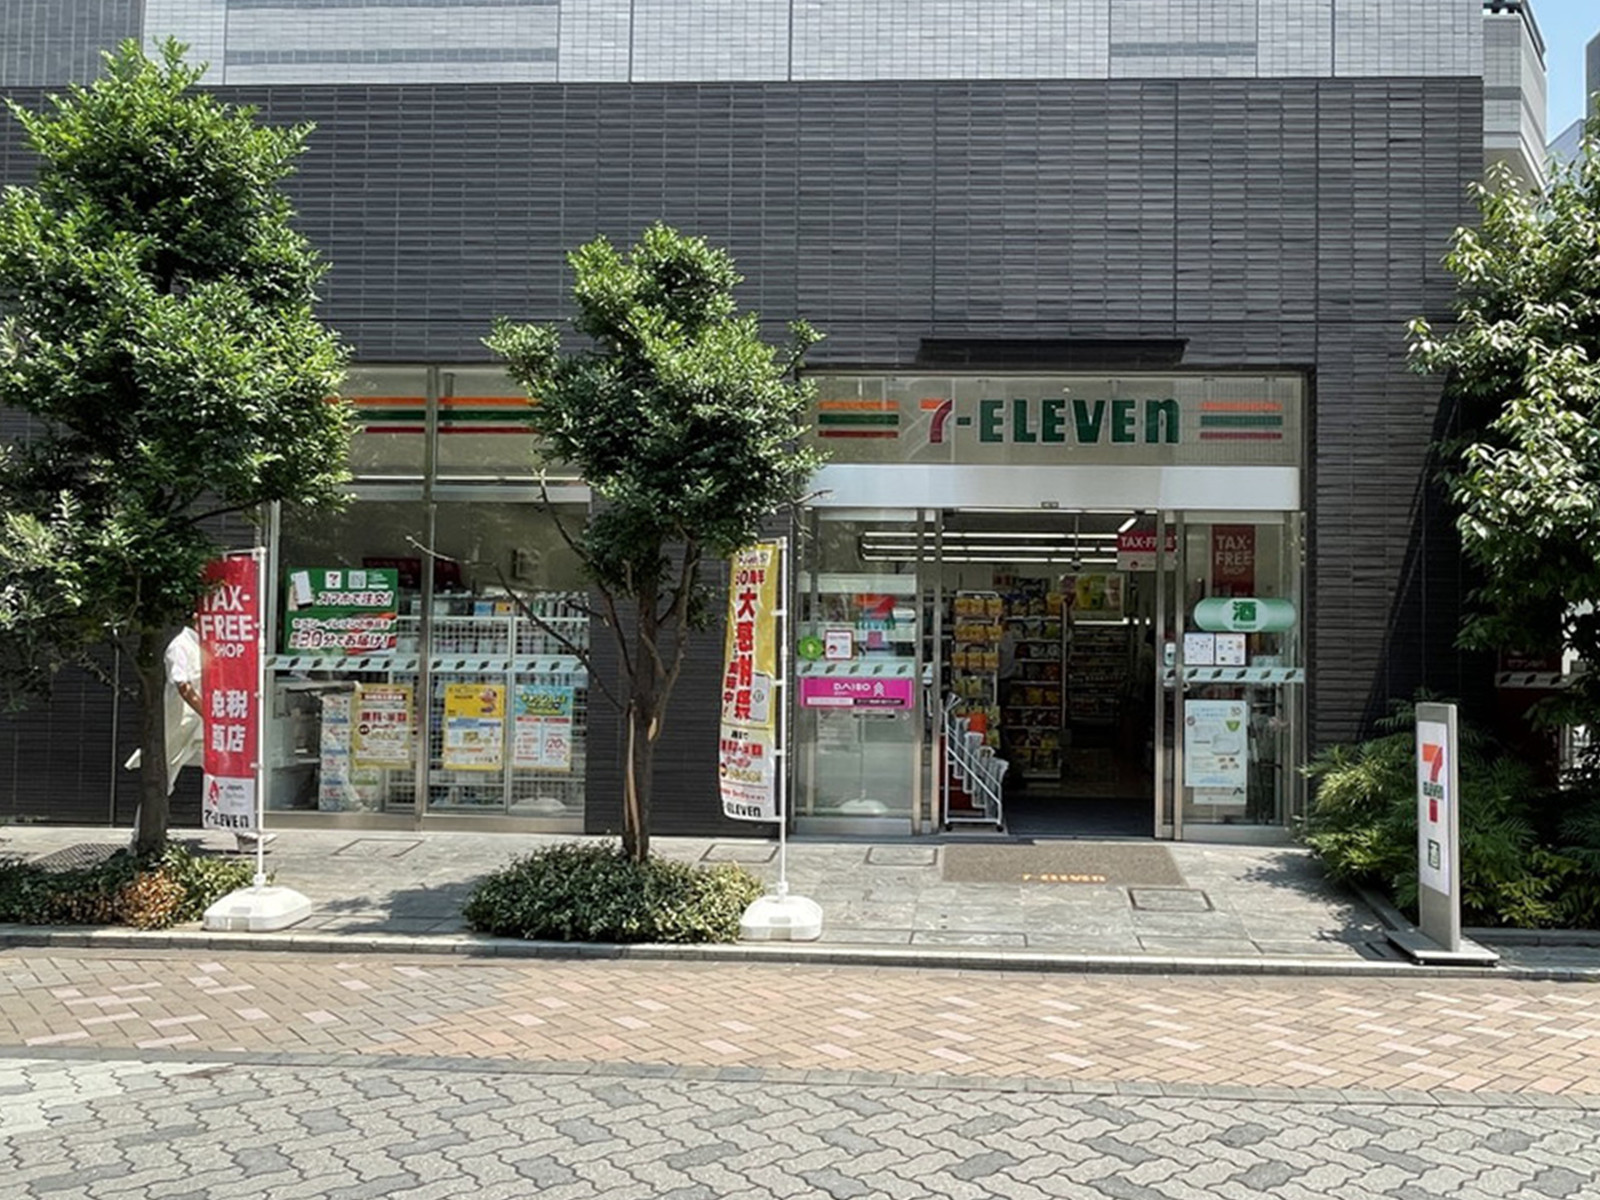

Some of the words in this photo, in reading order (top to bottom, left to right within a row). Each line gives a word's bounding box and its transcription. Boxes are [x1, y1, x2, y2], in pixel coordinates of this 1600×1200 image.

[1120, 536, 1174, 549] TAX-FE
[1216, 535, 1250, 550] TAX-
[1215, 550, 1252, 566] FREE
[1232, 601, 1257, 621] 酒
[201, 615, 253, 641] FREE
